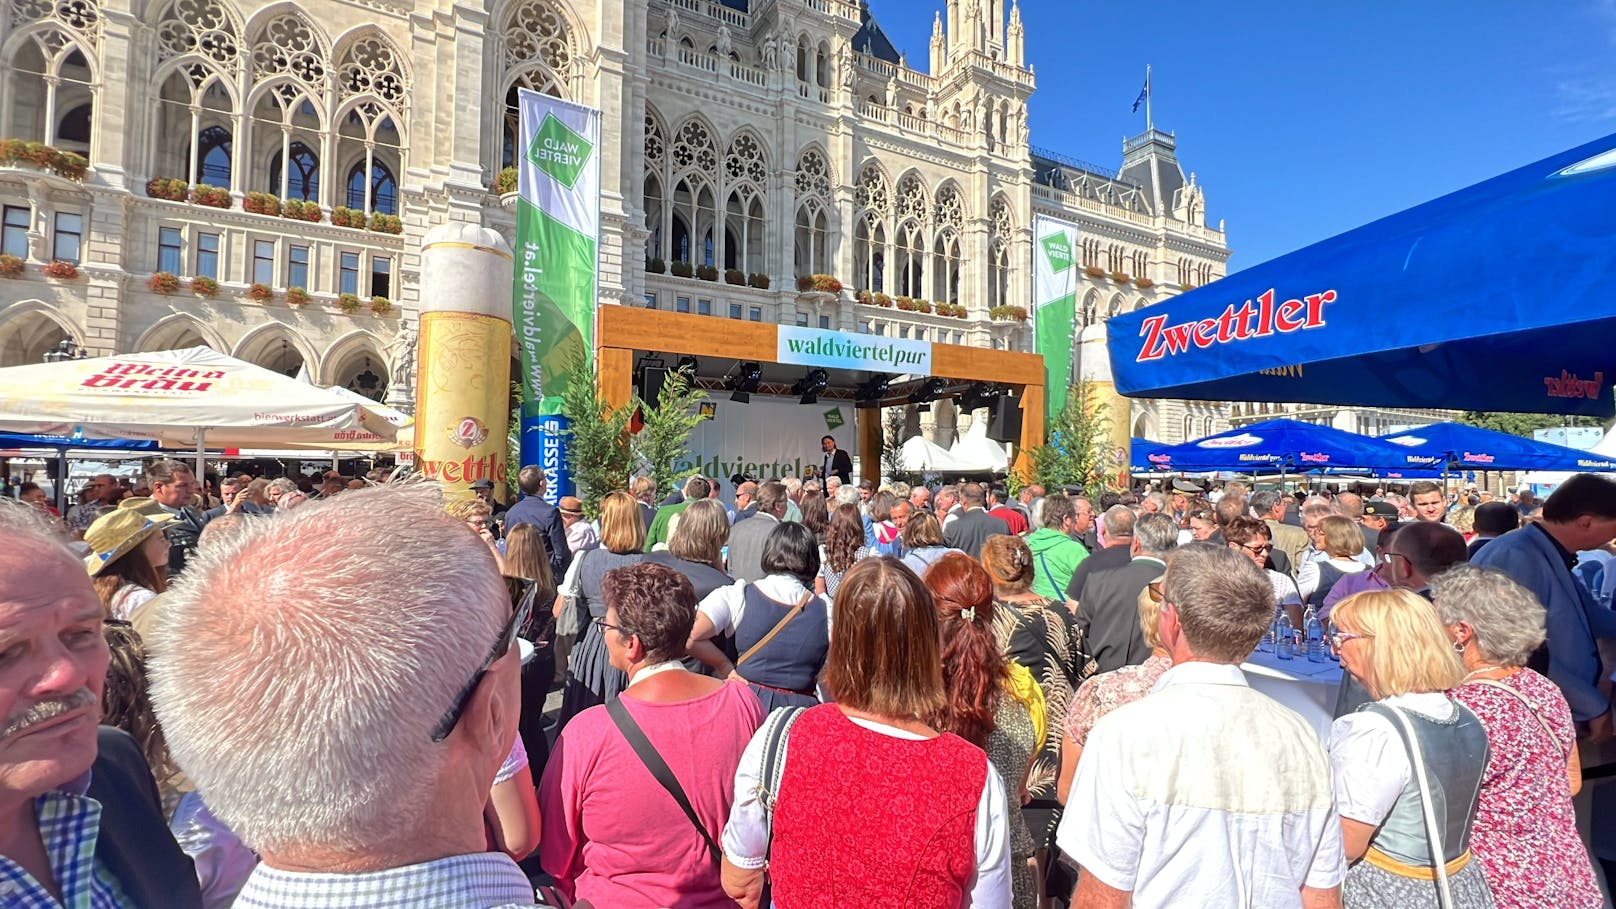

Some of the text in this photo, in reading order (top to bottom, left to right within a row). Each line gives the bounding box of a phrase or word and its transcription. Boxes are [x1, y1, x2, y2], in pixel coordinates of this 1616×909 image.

[1047, 250, 1070, 262] VIERTE
[1048, 242, 1069, 253] WALD
[1136, 288, 1338, 362] Zwettler
[80, 374, 213, 392] Bräu
[413, 449, 507, 483] wettle
[544, 434, 559, 507] ARKASSE
